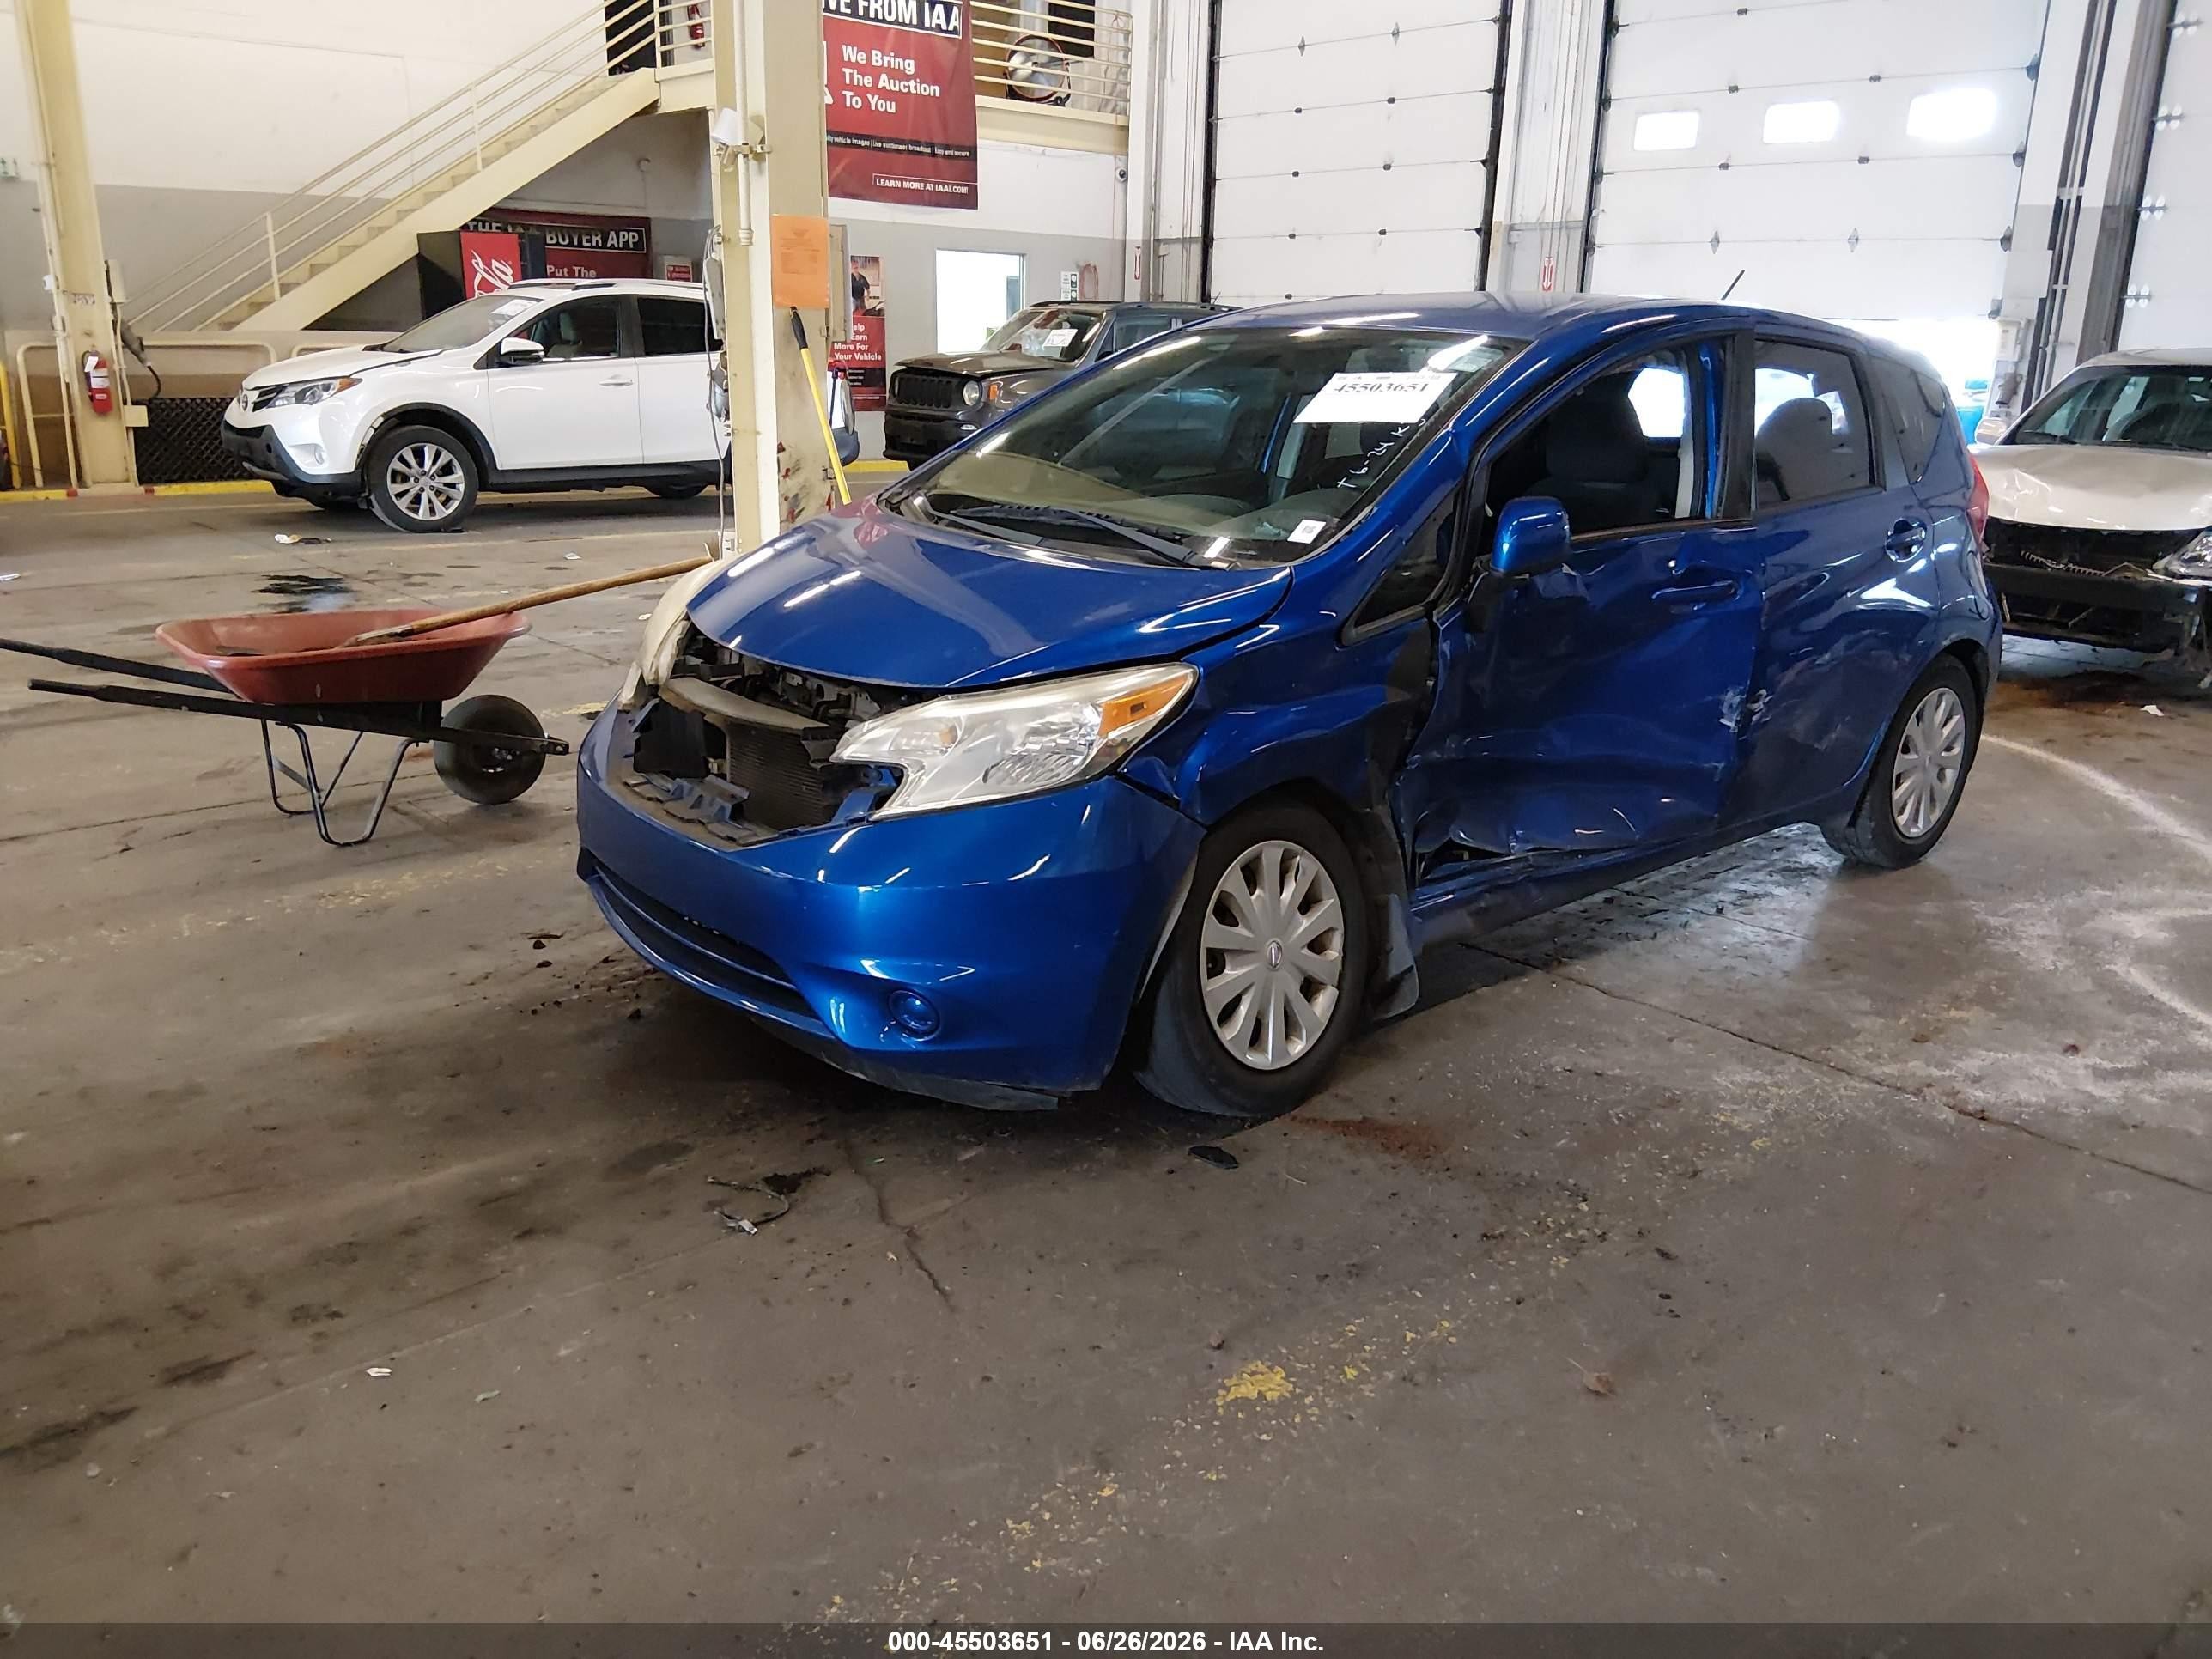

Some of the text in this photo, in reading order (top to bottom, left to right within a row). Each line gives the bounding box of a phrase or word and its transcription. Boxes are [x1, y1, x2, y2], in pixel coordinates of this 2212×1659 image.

[858, 0, 917, 25] FROM
[925, 2, 960, 31] IAA
[842, 45, 915, 75] We Bring
[842, 68, 940, 97] The Auction
[842, 90, 896, 113] To You
[876, 179, 902, 188] LEARN
[902, 181, 924, 190] MORE
[545, 228, 603, 247] BUYER
[607, 231, 640, 248] APP
[546, 264, 598, 278] Put The
[853, 322, 866, 333] elp
[856, 343, 869, 351] For
[854, 352, 882, 361] Vehicle
[1333, 383, 1430, 392] 45503651
